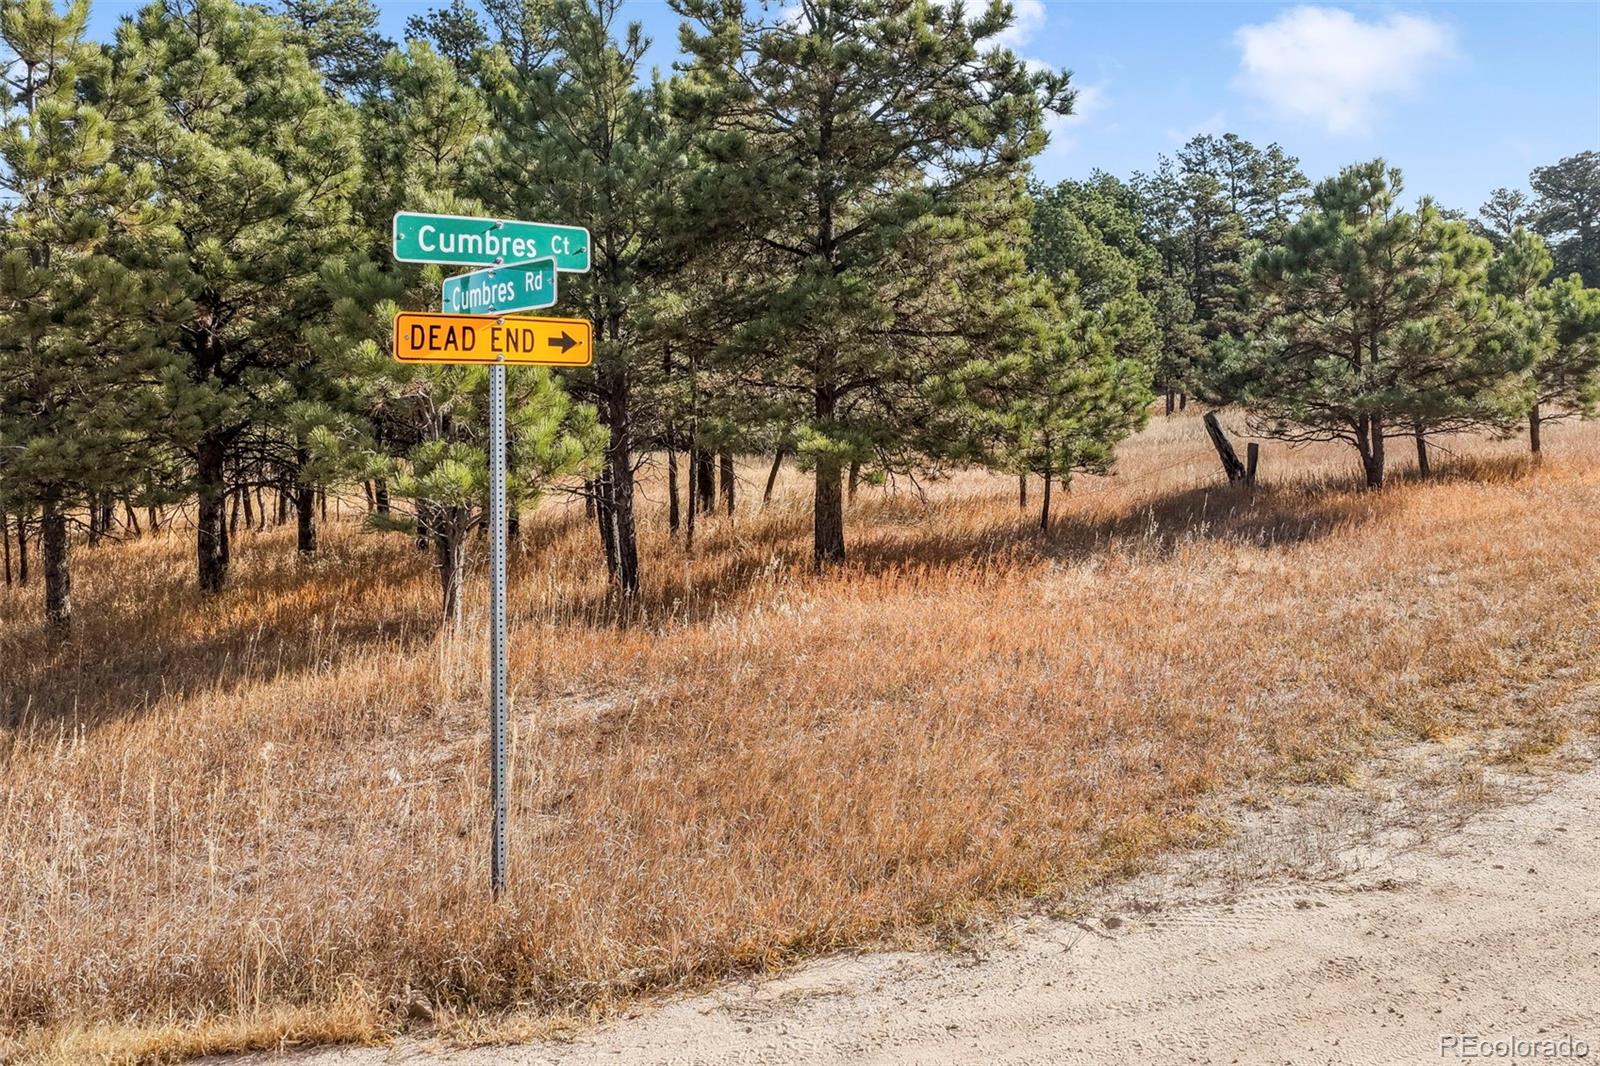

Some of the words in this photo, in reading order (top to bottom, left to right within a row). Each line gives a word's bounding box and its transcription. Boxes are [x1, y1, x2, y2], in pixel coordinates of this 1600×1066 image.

[418, 225, 537, 258] Cumbres
[551, 235, 570, 255] Ct
[452, 280, 515, 311] Cumbres
[525, 270, 543, 292] Rd
[410, 324, 476, 351] DEAD
[491, 327, 535, 353] END
